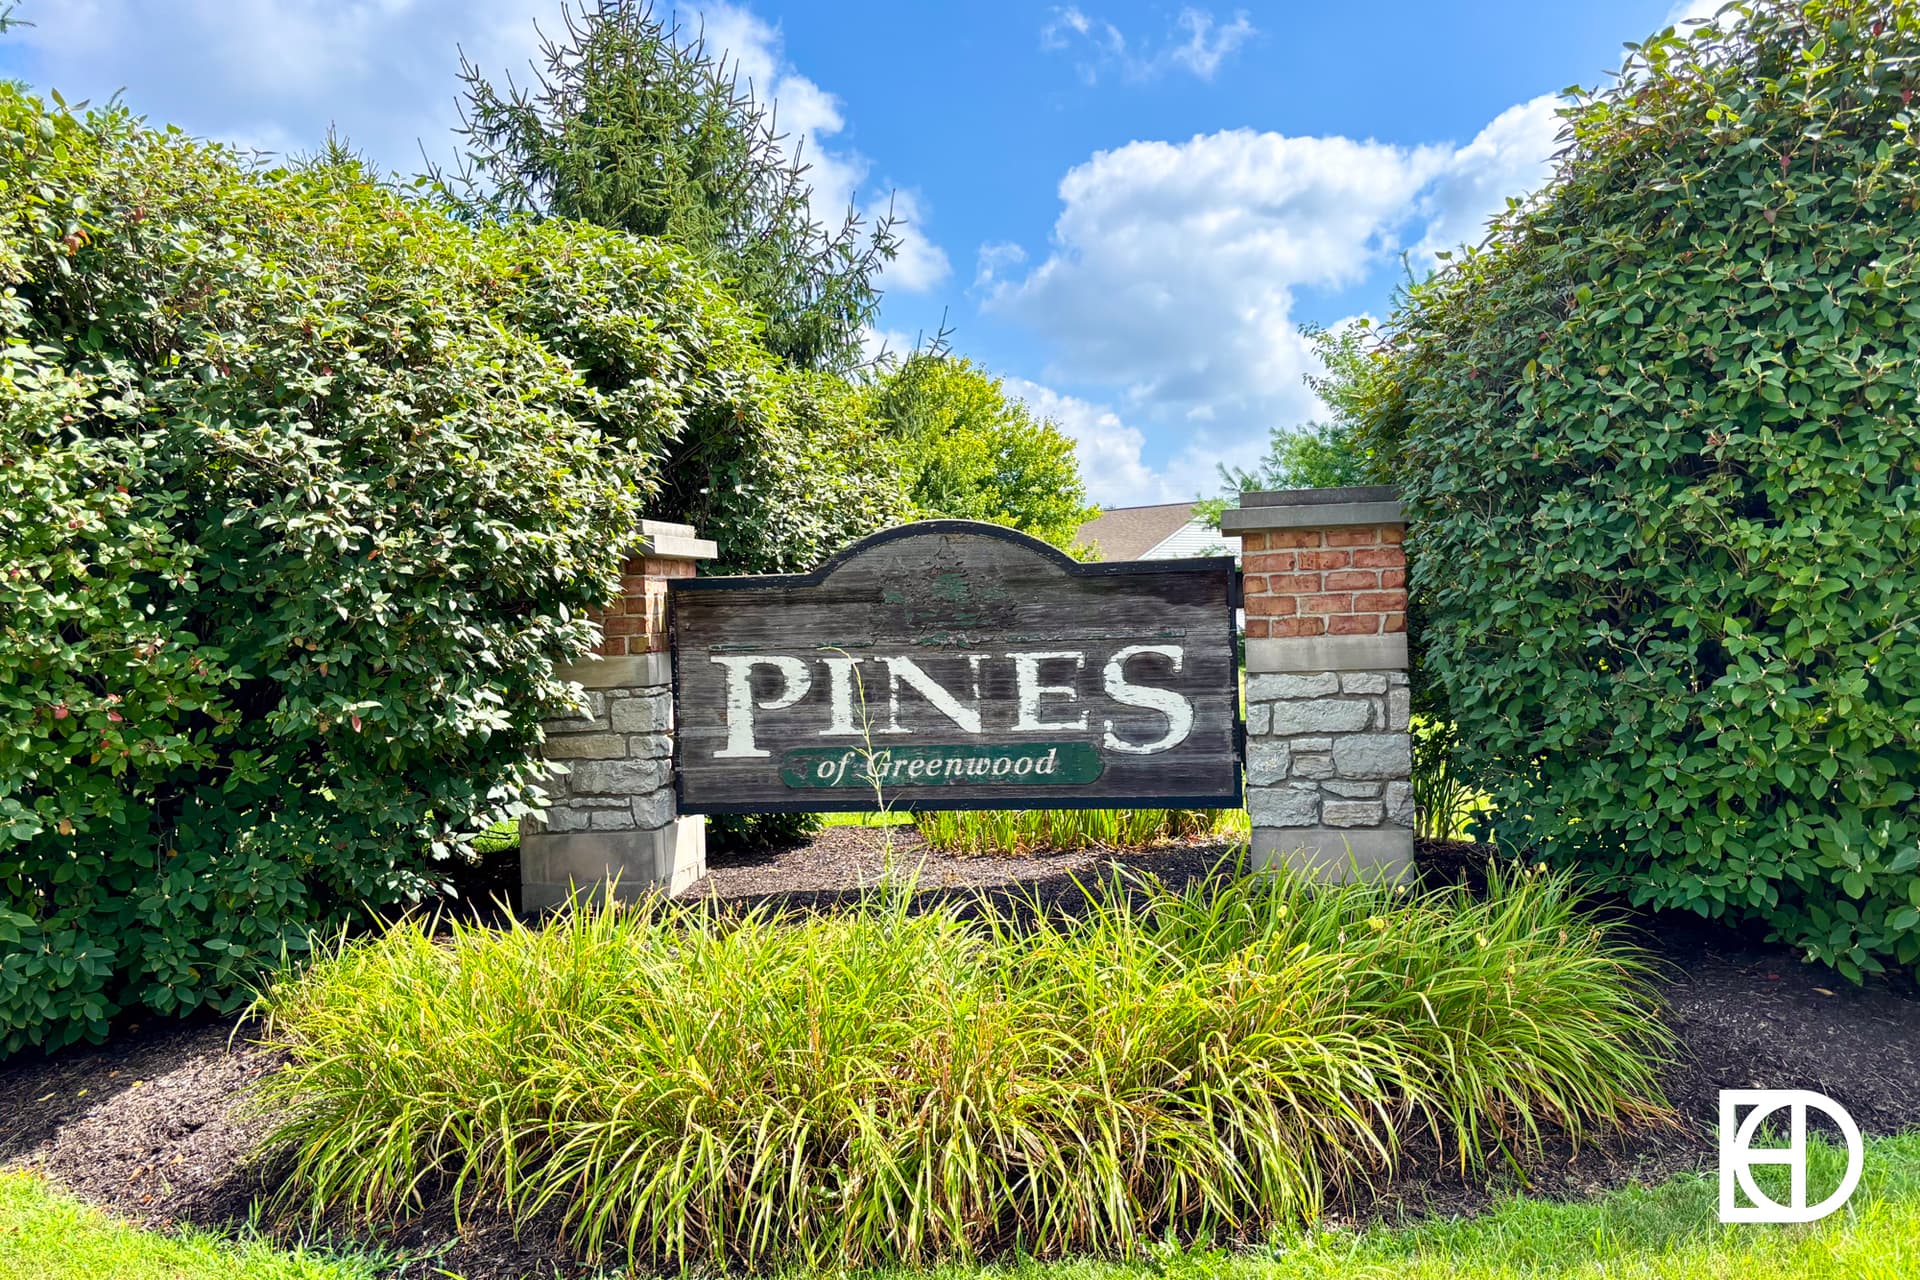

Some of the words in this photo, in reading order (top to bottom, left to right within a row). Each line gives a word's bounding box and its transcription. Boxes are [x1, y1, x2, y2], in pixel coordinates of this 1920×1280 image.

[710, 645, 1195, 758] PINES
[816, 751, 855, 787] of
[866, 747, 1057, 778] Greenwood
